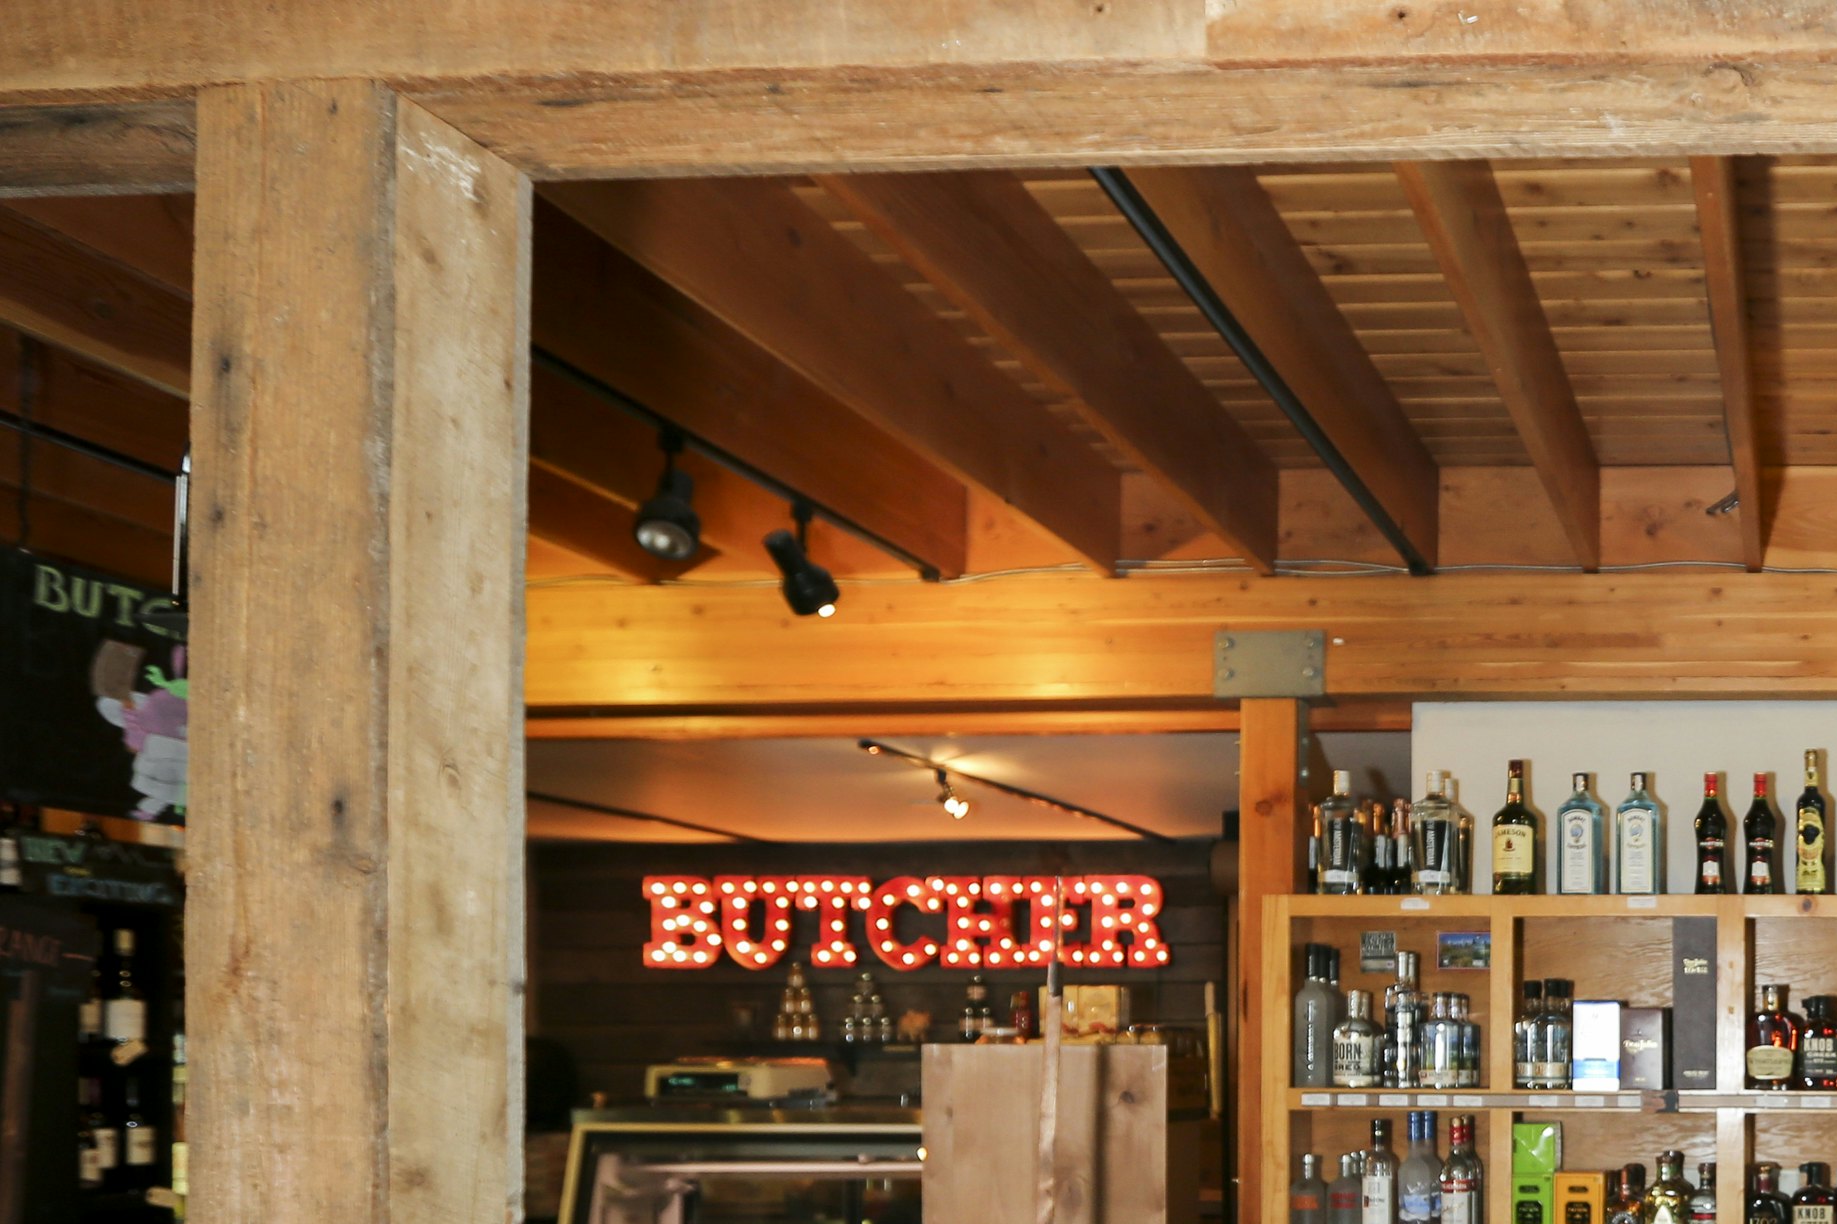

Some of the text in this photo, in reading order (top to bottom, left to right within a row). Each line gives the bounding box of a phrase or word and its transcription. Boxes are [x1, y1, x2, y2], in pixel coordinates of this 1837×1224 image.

[642, 875, 1172, 969] BUTCHER
[1334, 1043, 1361, 1060] BORN
[1803, 1038, 1833, 1051] KNOB
[1797, 1207, 1826, 1220] KNOB
